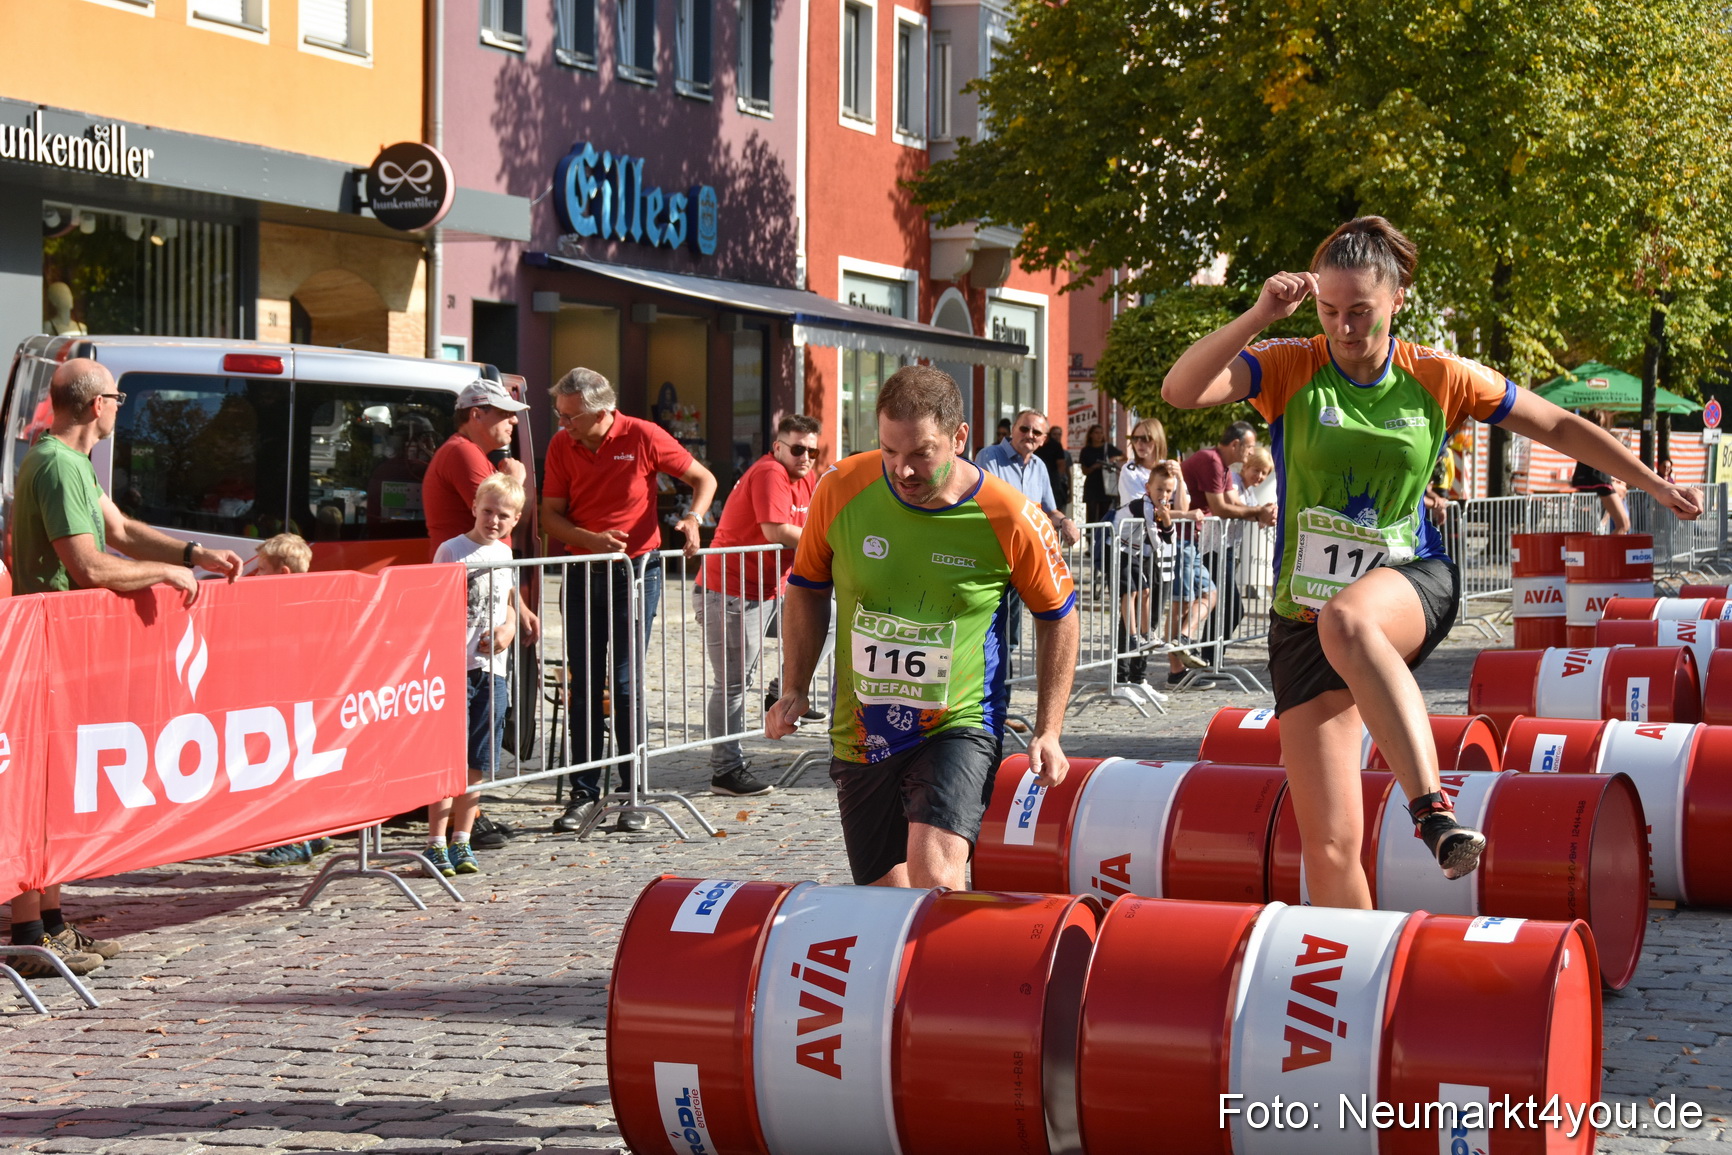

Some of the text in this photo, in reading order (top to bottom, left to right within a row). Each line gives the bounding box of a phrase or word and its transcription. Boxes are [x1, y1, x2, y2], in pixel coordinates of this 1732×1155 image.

[0, 110, 155, 179] unkemöller
[562, 141, 689, 250] Eilles
[1068, 409, 1098, 425] NEZIA
[1385, 417, 1426, 430] BOCK
[931, 552, 976, 569] BOCK
[1022, 500, 1071, 594] BOCK
[853, 611, 946, 646] BOCK
[864, 645, 927, 678] 116
[341, 652, 446, 731] energie
[859, 679, 923, 698] STEFAN
[1031, 923, 1044, 940] 323
[1012, 1051, 1025, 1112] 12414-B&B
[691, 1088, 706, 1129] energie
